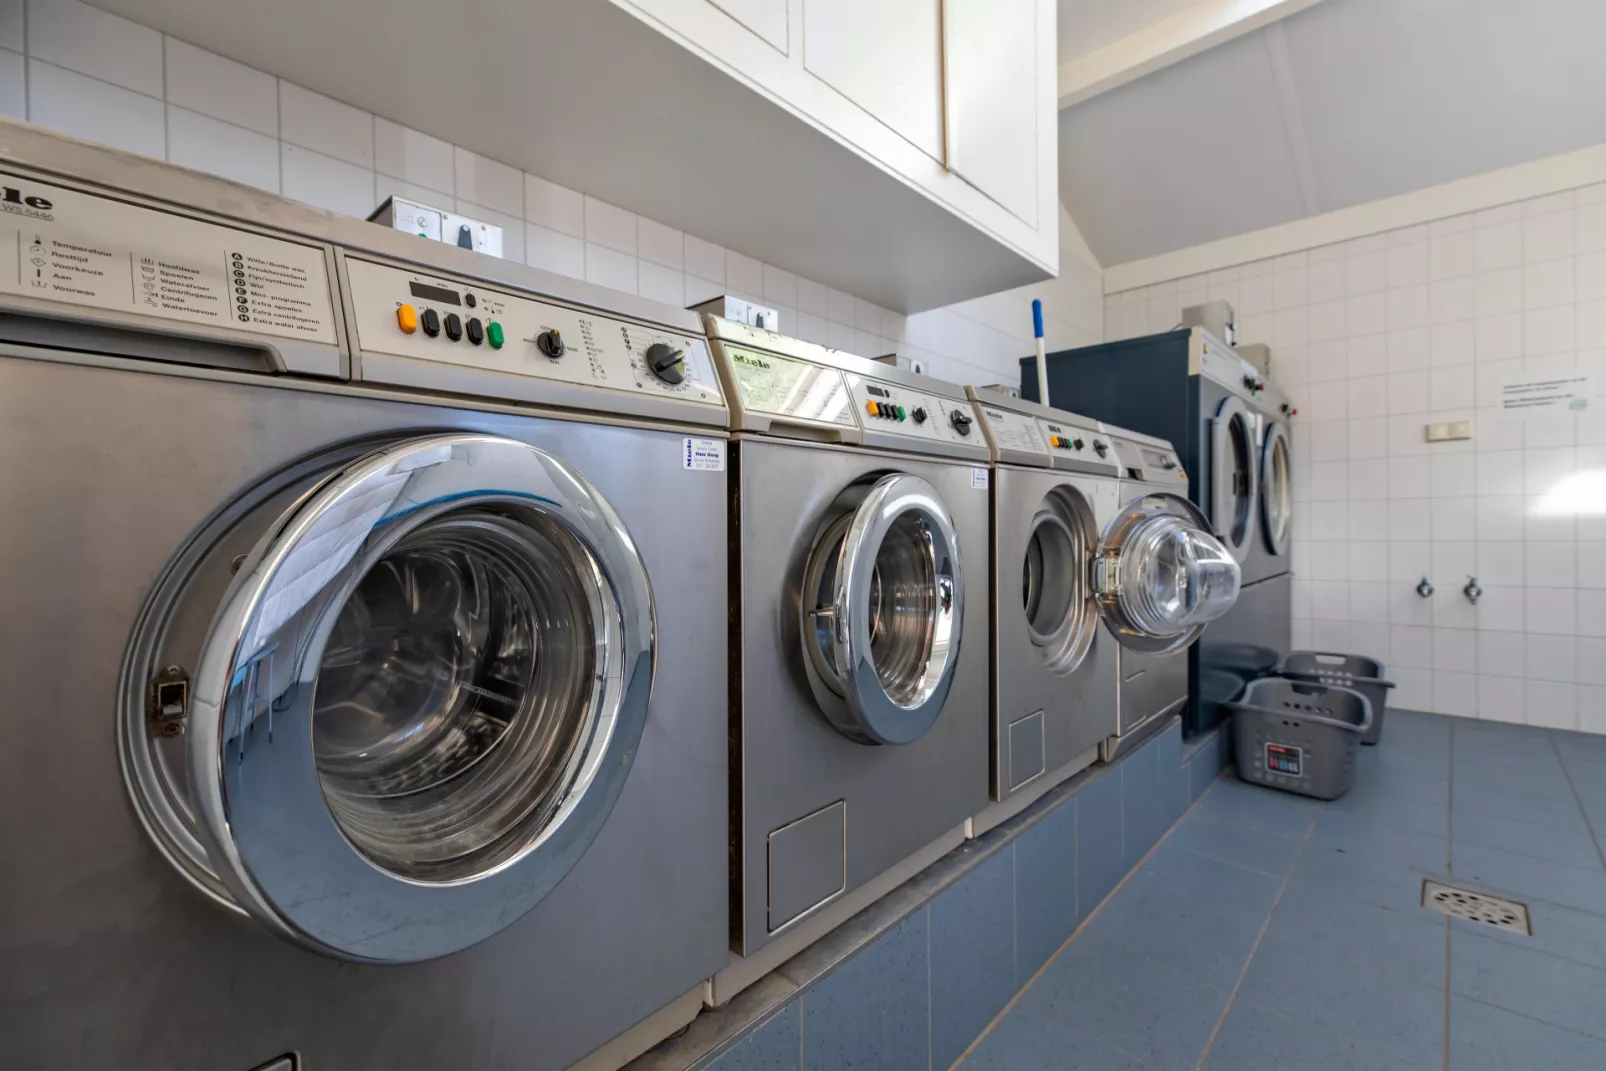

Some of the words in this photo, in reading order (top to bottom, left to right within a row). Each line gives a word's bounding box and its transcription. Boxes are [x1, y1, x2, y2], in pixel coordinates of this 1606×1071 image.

[0, 186, 53, 210] le
[2, 203, 22, 214] WS
[25, 209, 54, 220] 5446
[52, 240, 112, 257] Temperatuur
[52, 252, 88, 263] Resttijd
[52, 262, 104, 276] Voorkeuze
[158, 262, 200, 274] Hoofdwas
[160, 270, 194, 280] Spoelen
[53, 284, 95, 296] Voorwas
[160, 278, 210, 291] Waterafvoer
[160, 286, 218, 300] Centrifugeren
[161, 295, 185, 303] Einde
[271, 295, 311, 307] programma
[162, 303, 218, 316] Watertoevoer
[274, 313, 320, 324] centrifugeren
[733, 354, 771, 369] Miele
